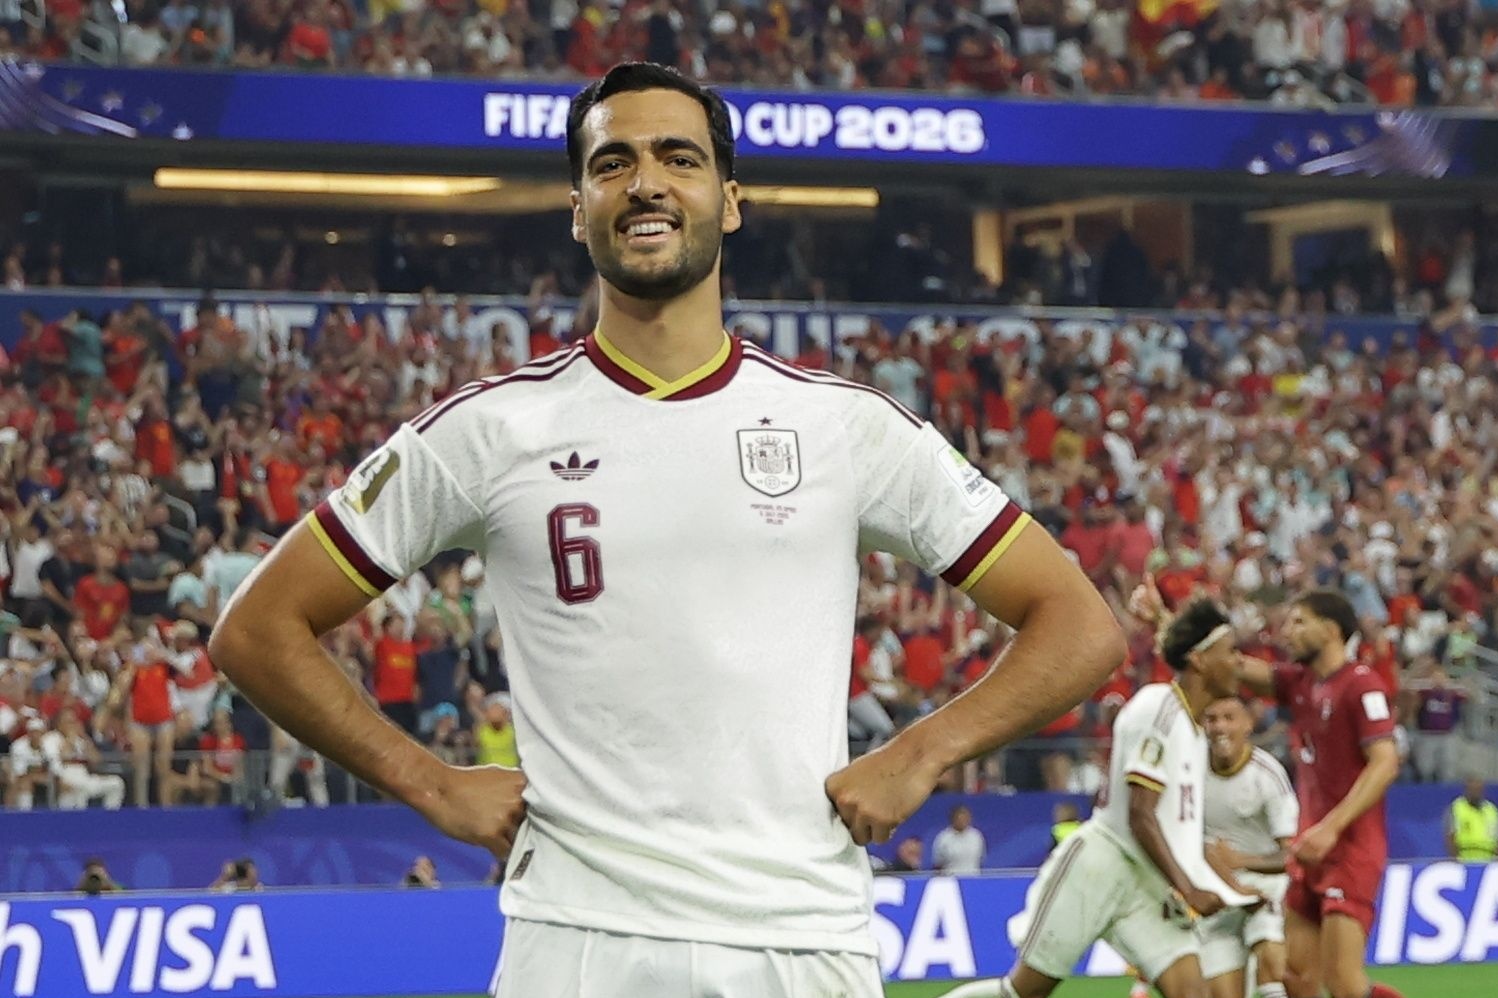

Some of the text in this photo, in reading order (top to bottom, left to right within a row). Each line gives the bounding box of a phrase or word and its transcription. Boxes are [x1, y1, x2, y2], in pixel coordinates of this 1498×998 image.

[745, 102, 832, 148] CUP
[835, 105, 987, 154] 2026
[547, 502, 605, 606] 6
[51, 903, 278, 995] VISA
[872, 876, 977, 980] SA
